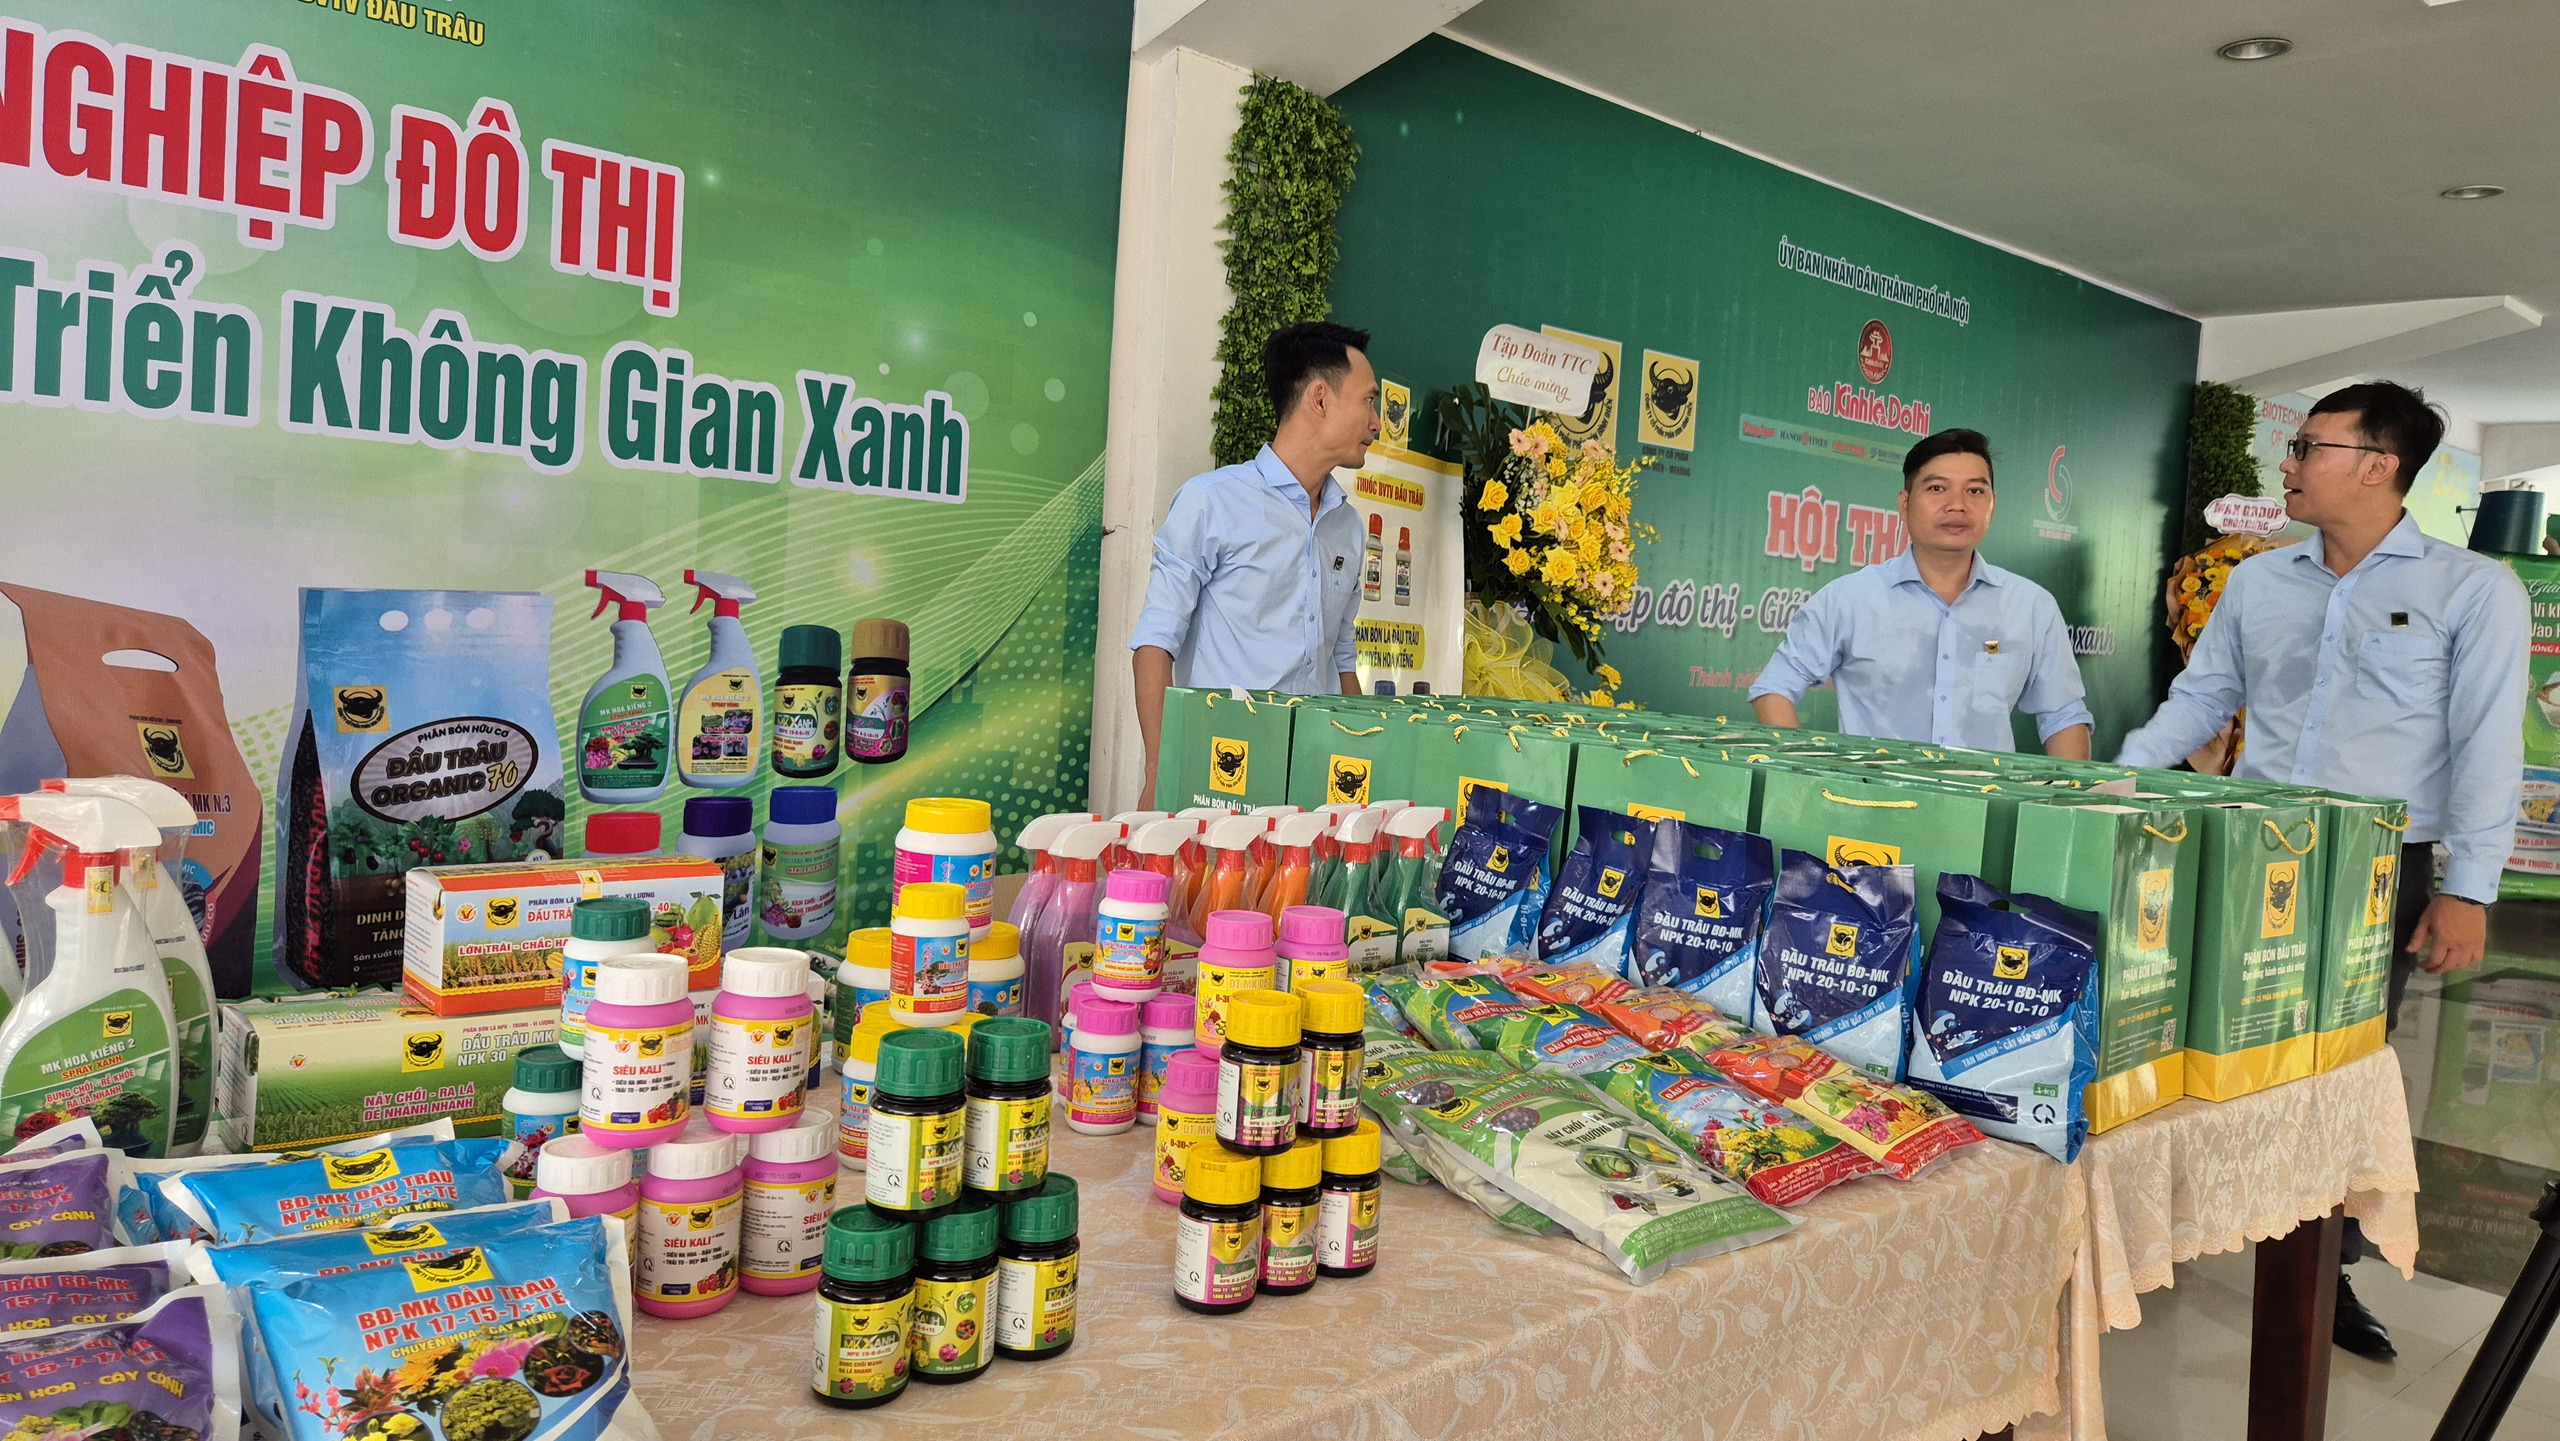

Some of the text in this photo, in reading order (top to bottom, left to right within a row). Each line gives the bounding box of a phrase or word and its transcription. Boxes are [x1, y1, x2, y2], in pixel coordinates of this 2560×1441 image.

[422, 8, 485, 46] TRÂU
[396, 106, 520, 254] ĐÔ
[551, 147, 676, 309] THỊ
[1778, 235, 1970, 326] ỦY BAN NHÂN DÂN THÀNH PHỐ HÀ NỘI
[1493, 333, 1518, 359] Tập
[1561, 352, 1592, 375] TTC
[1497, 366, 1571, 403] Chúc mừng
[288, 299, 578, 468] Không
[607, 348, 778, 476] Gian
[797, 377, 965, 497] Xanh
[1808, 386, 1832, 415] BÁO
[1356, 474, 1377, 495] THUỐC
[1765, 485, 1911, 572] HỘI TH
[1656, 578, 1695, 627] đô
[1698, 582, 1740, 639] thị
[1758, 586, 1813, 634] Giả
[2074, 621, 2116, 655] xanh
[1371, 623, 1382, 644] BÓN
[1405, 627, 1419, 646] TRÂU
[1383, 652, 1395, 668] HOA
[417, 722, 510, 744] PHÂN BÓN HỮU CƠ
[386, 739, 508, 779] ĐẦU TRÂU
[370, 760, 519, 808] ORGANIC 70
[213, 793, 232, 814] N.3
[1193, 793, 1242, 813] PHÂN BÓN ĐẦU
[1454, 859, 1496, 885] ĐẦU TRÂU
[1454, 876, 1473, 891] NPK
[657, 902, 670, 912] 40
[1562, 885, 1606, 912] ĐẦU TRÂU
[1563, 902, 1582, 917] NPK
[357, 911, 393, 926] DINH
[528, 907, 550, 922] ĐẦU
[1653, 911, 1681, 933] ĐẦU
[1682, 918, 1711, 935] TRÂU
[459, 937, 555, 956] LỚN TRÁI CHẮC
[1660, 928, 1734, 953] NPK 20-10-10
[372, 948, 392, 959] xuất
[1780, 947, 1808, 967] ĐẦU
[1810, 956, 1845, 974] TRÂU
[2262, 946, 2277, 963] BÓN
[2290, 941, 2307, 958] TRÂU
[1787, 968, 1878, 998] NPK 20-10-10
[1942, 967, 1973, 989] ĐẦU
[1976, 978, 2013, 997] TRÂU
[1949, 990, 2050, 1018] NPK 20-10-10
[462, 1030, 554, 1051] ĐẦU TRÂU MK
[41, 1038, 136, 1074] MK HOA 2
[62, 1054, 123, 1080] SPRAY XANH
[457, 1049, 507, 1067] NPK 30
[747, 1053, 792, 1065] SIÊU KALI
[1568, 1054, 1593, 1069] CHUYÊN
[1961, 1046, 1999, 1068] TAN NHANH
[613, 1064, 662, 1076] SIÊU KALI
[1403, 1061, 1431, 1076] NPK
[46, 1089, 71, 1102] BUNG
[66, 1085, 122, 1110] RA NHANH
[439, 1086, 456, 1098] RA
[459, 1082, 475, 1096] LÁ
[1480, 1086, 1510, 1102] NPK
[1665, 1084, 1681, 1100] ĐẦU
[432, 1097, 474, 1113] NHANH
[277, 1169, 455, 1212] BĐ-MK ĐẦU TRÂU
[9, 1208, 97, 1231] CÂY CẢNH
[281, 1209, 330, 1226] NPK
[302, 1204, 415, 1232] CHUYÊN HOA CÂY
[803, 1212, 822, 1225] SIÊU
[663, 1236, 712, 1248] SIÊU KALI
[59, 1274, 134, 1291] BĐ-MK
[356, 1277, 558, 1333] BĐ-MK ĐẦU TRÂU
[7, 1311, 108, 1332] HOA CÂY
[364, 1323, 423, 1353] NPK
[390, 1319, 517, 1360] CHUYÊN HOA CÂY
[29, 1370, 186, 1399] HOA CÂY CẢNH
